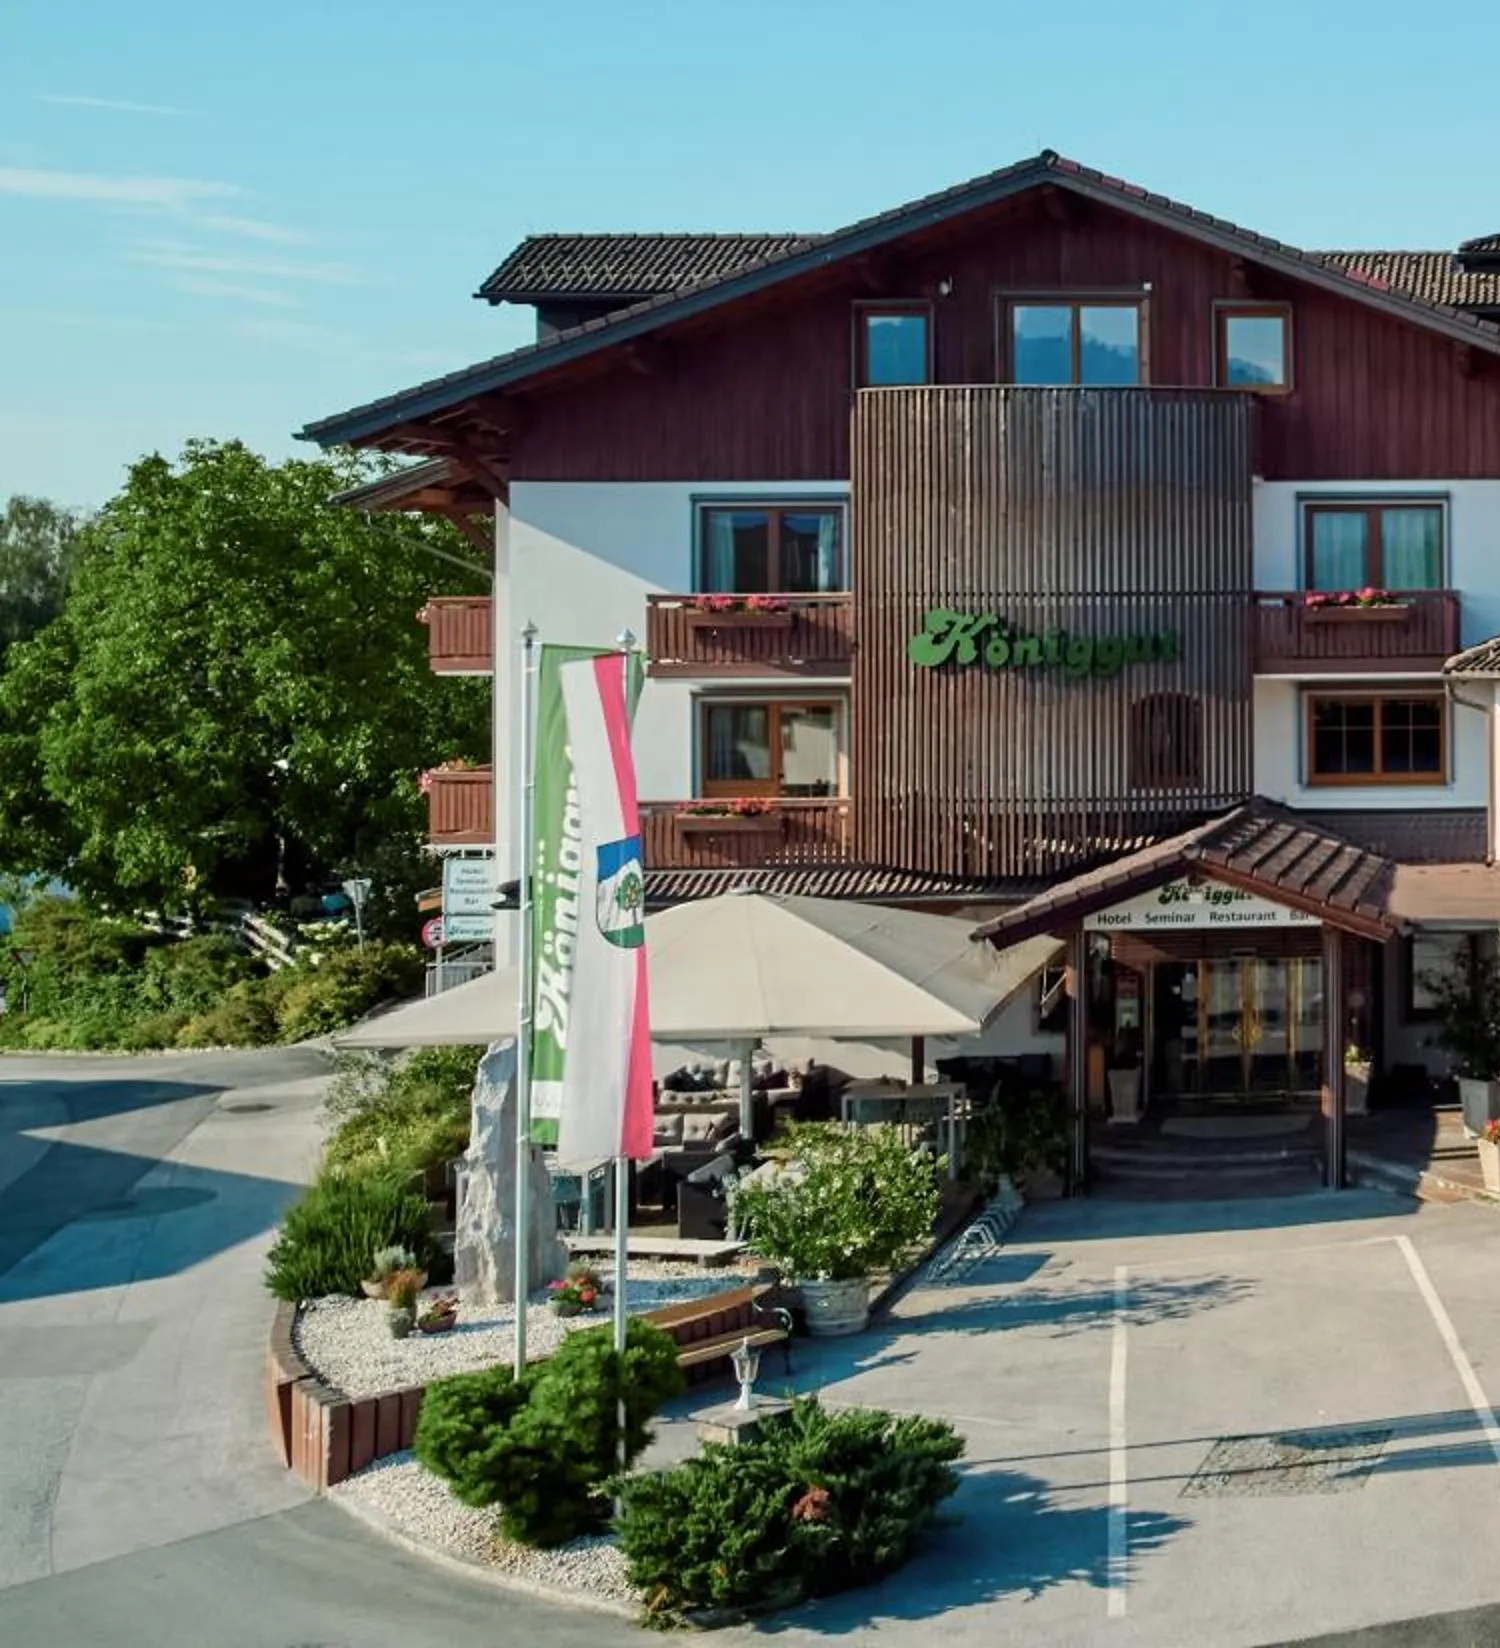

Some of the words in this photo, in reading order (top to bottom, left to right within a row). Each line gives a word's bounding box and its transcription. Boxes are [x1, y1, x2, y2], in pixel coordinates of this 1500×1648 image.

[908, 607, 1179, 677] Königgut
[1096, 912, 1132, 925] Hotel
[1145, 911, 1197, 924] Seminar
[1209, 910, 1277, 923] Restaurant
